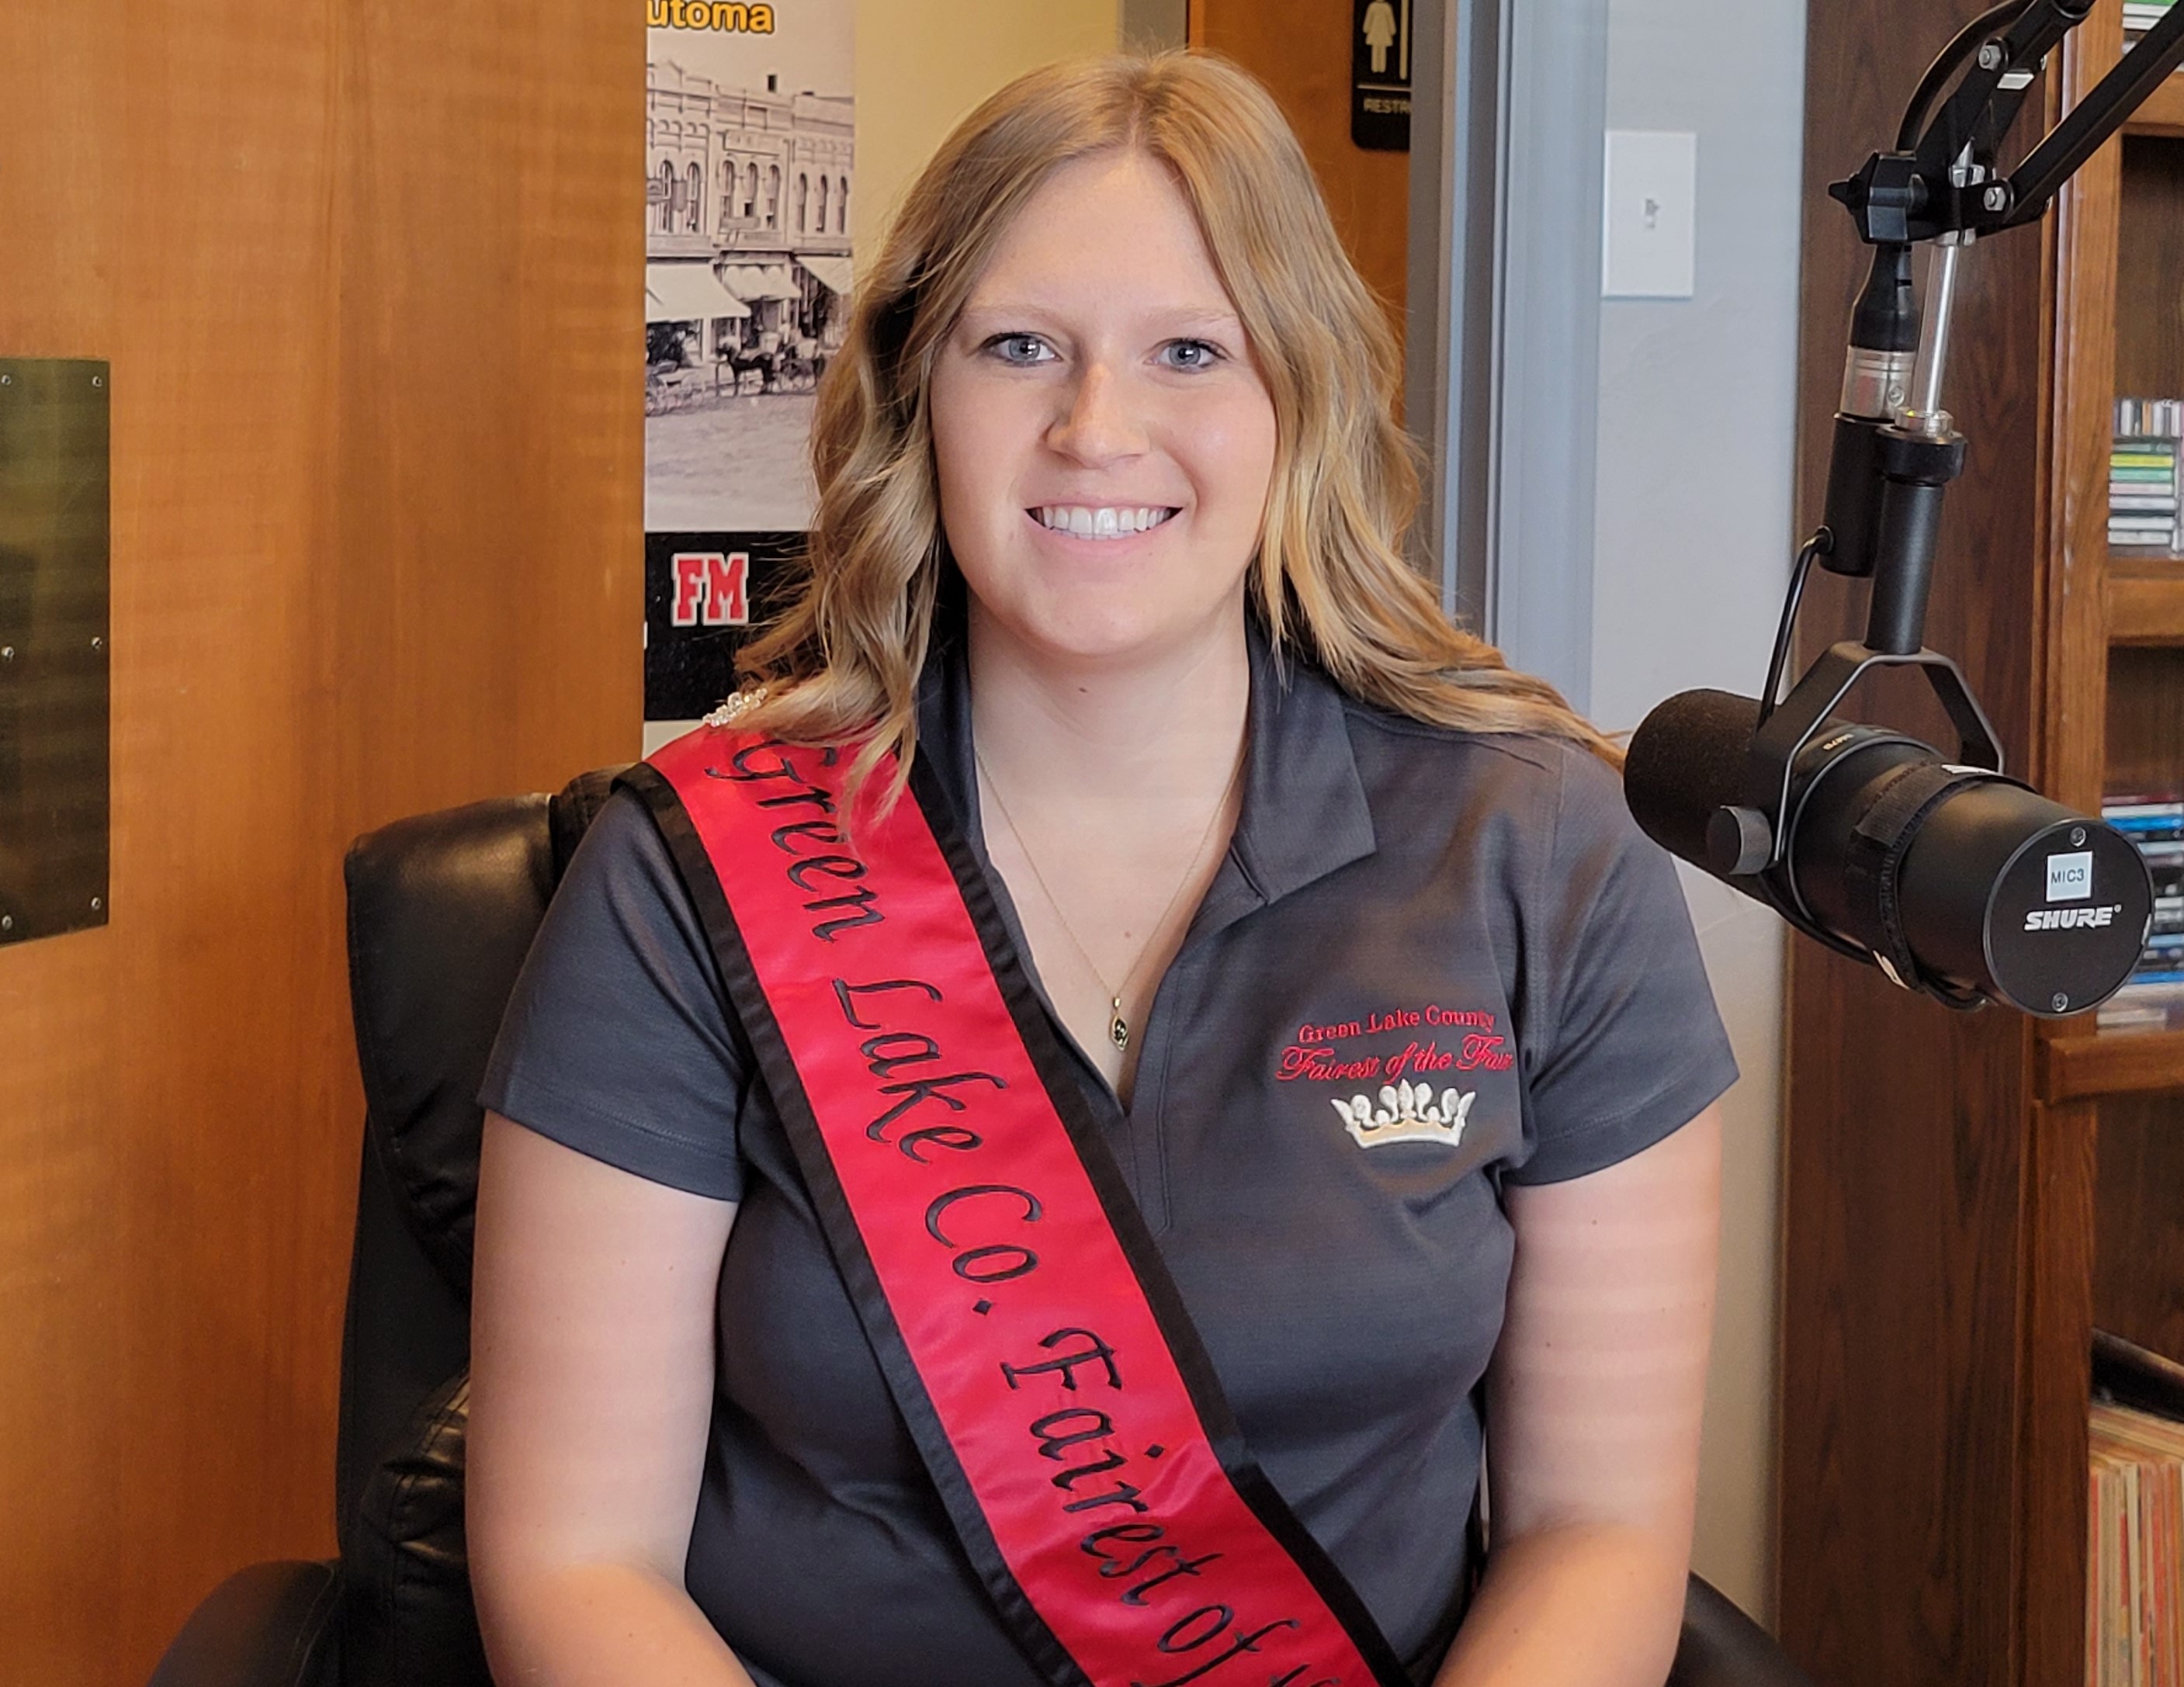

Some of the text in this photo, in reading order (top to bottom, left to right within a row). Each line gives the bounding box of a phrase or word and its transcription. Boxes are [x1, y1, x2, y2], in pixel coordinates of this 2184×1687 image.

[672, 553, 749, 626] FM
[2051, 868, 2085, 883] MIC3
[1298, 1005, 1496, 1044] Green Lake County
[1275, 1045, 1381, 1081] Fairest
[1383, 1041, 1418, 1084] of
[1414, 1041, 1453, 1072] the
[704, 739, 1301, 1687] Green Lake Co. Fairest of
